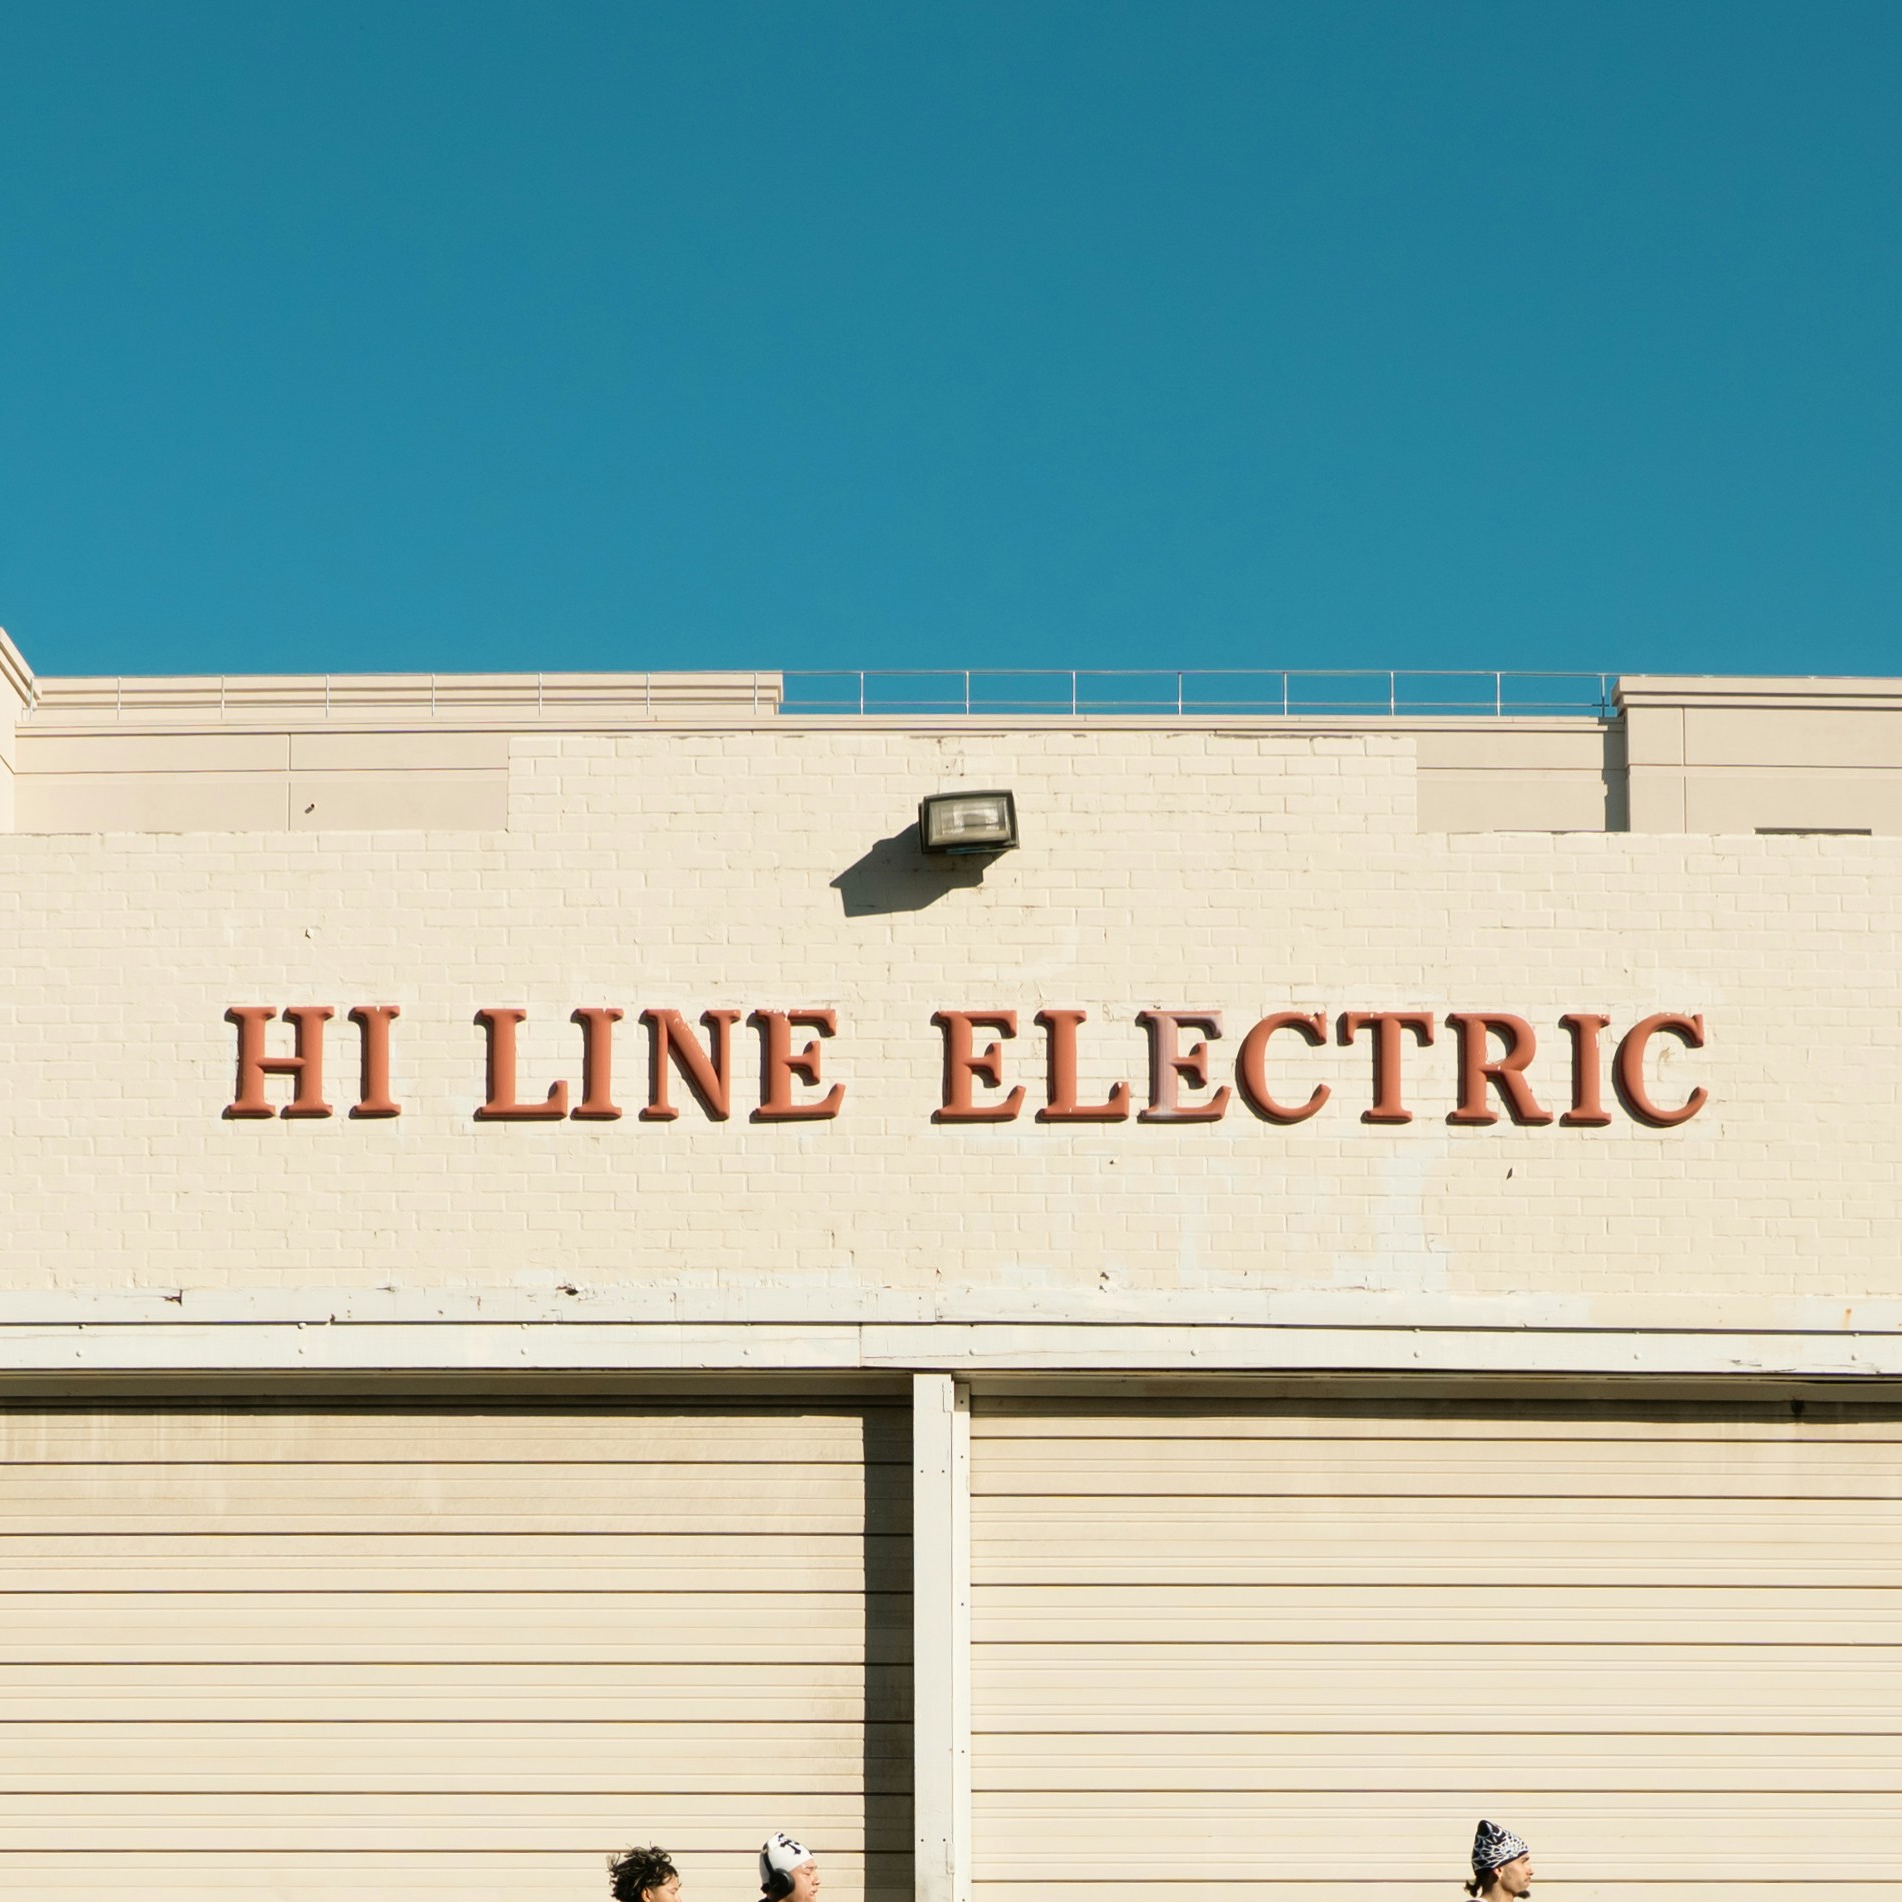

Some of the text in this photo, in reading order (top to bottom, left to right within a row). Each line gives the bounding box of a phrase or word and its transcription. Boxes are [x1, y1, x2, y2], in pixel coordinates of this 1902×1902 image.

[221, 1005, 1709, 1127] HI LINE ELECTRIC
